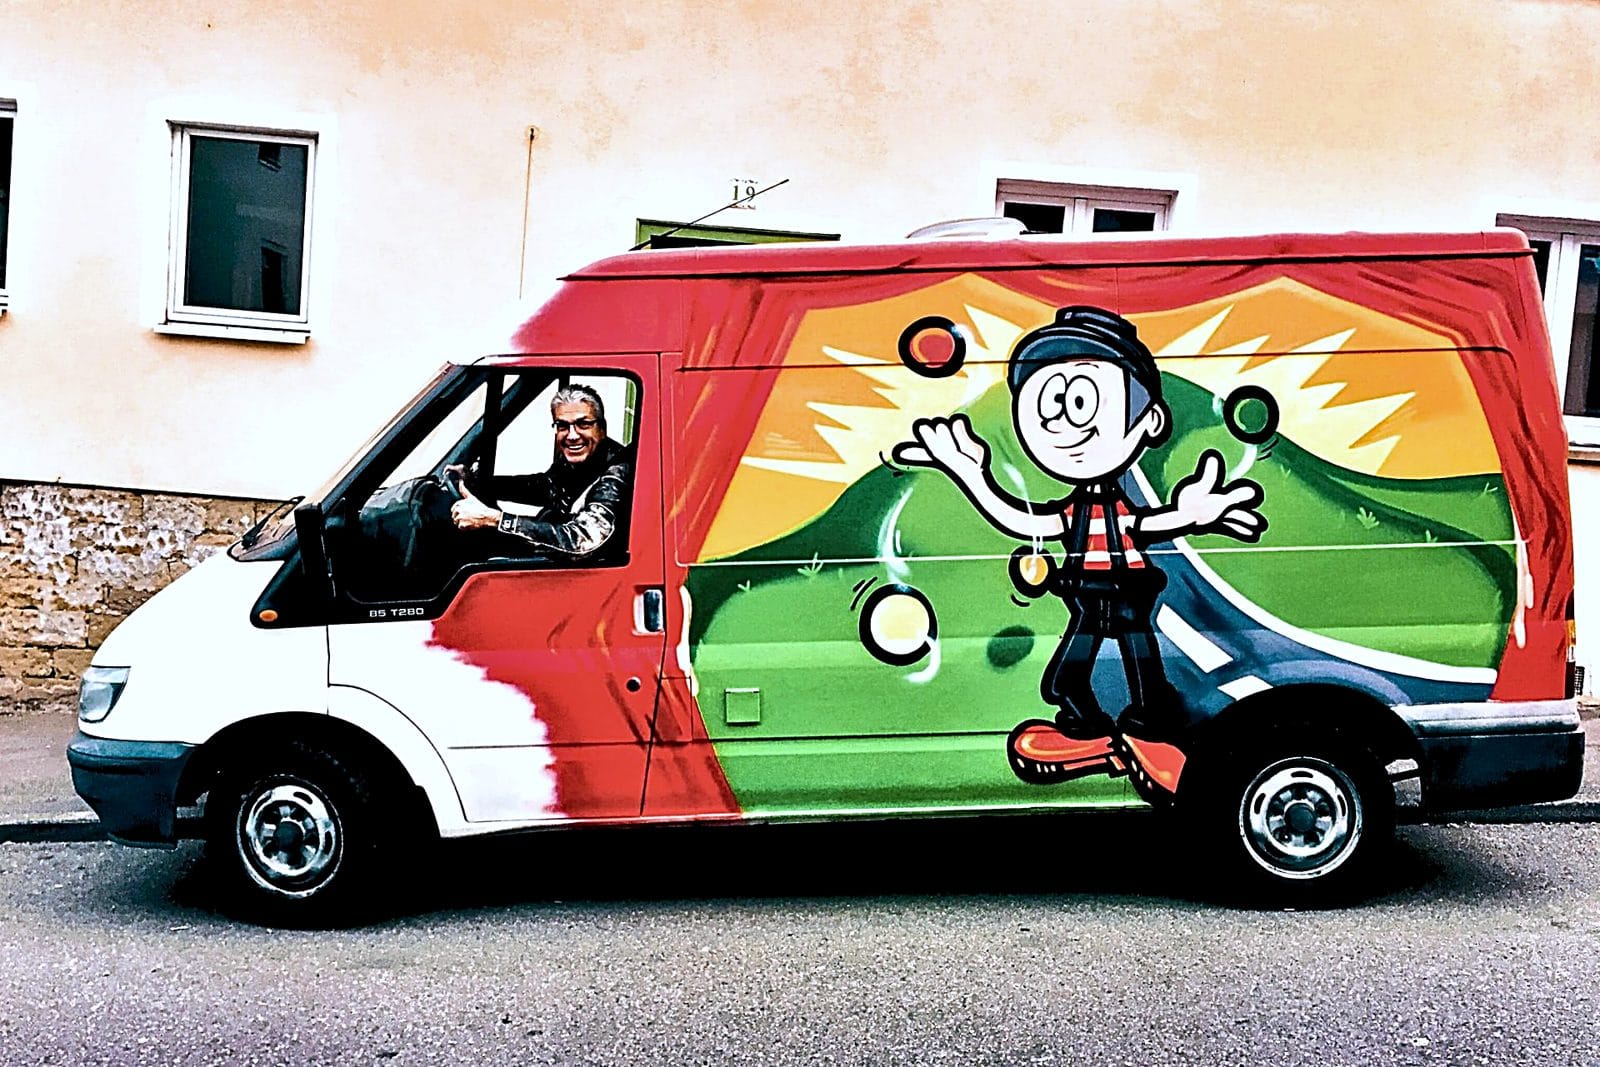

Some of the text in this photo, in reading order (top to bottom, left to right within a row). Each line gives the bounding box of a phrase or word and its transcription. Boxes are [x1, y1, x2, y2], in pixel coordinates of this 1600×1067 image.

[732, 185, 756, 202] 19
[369, 607, 424, 617] 85 T280
